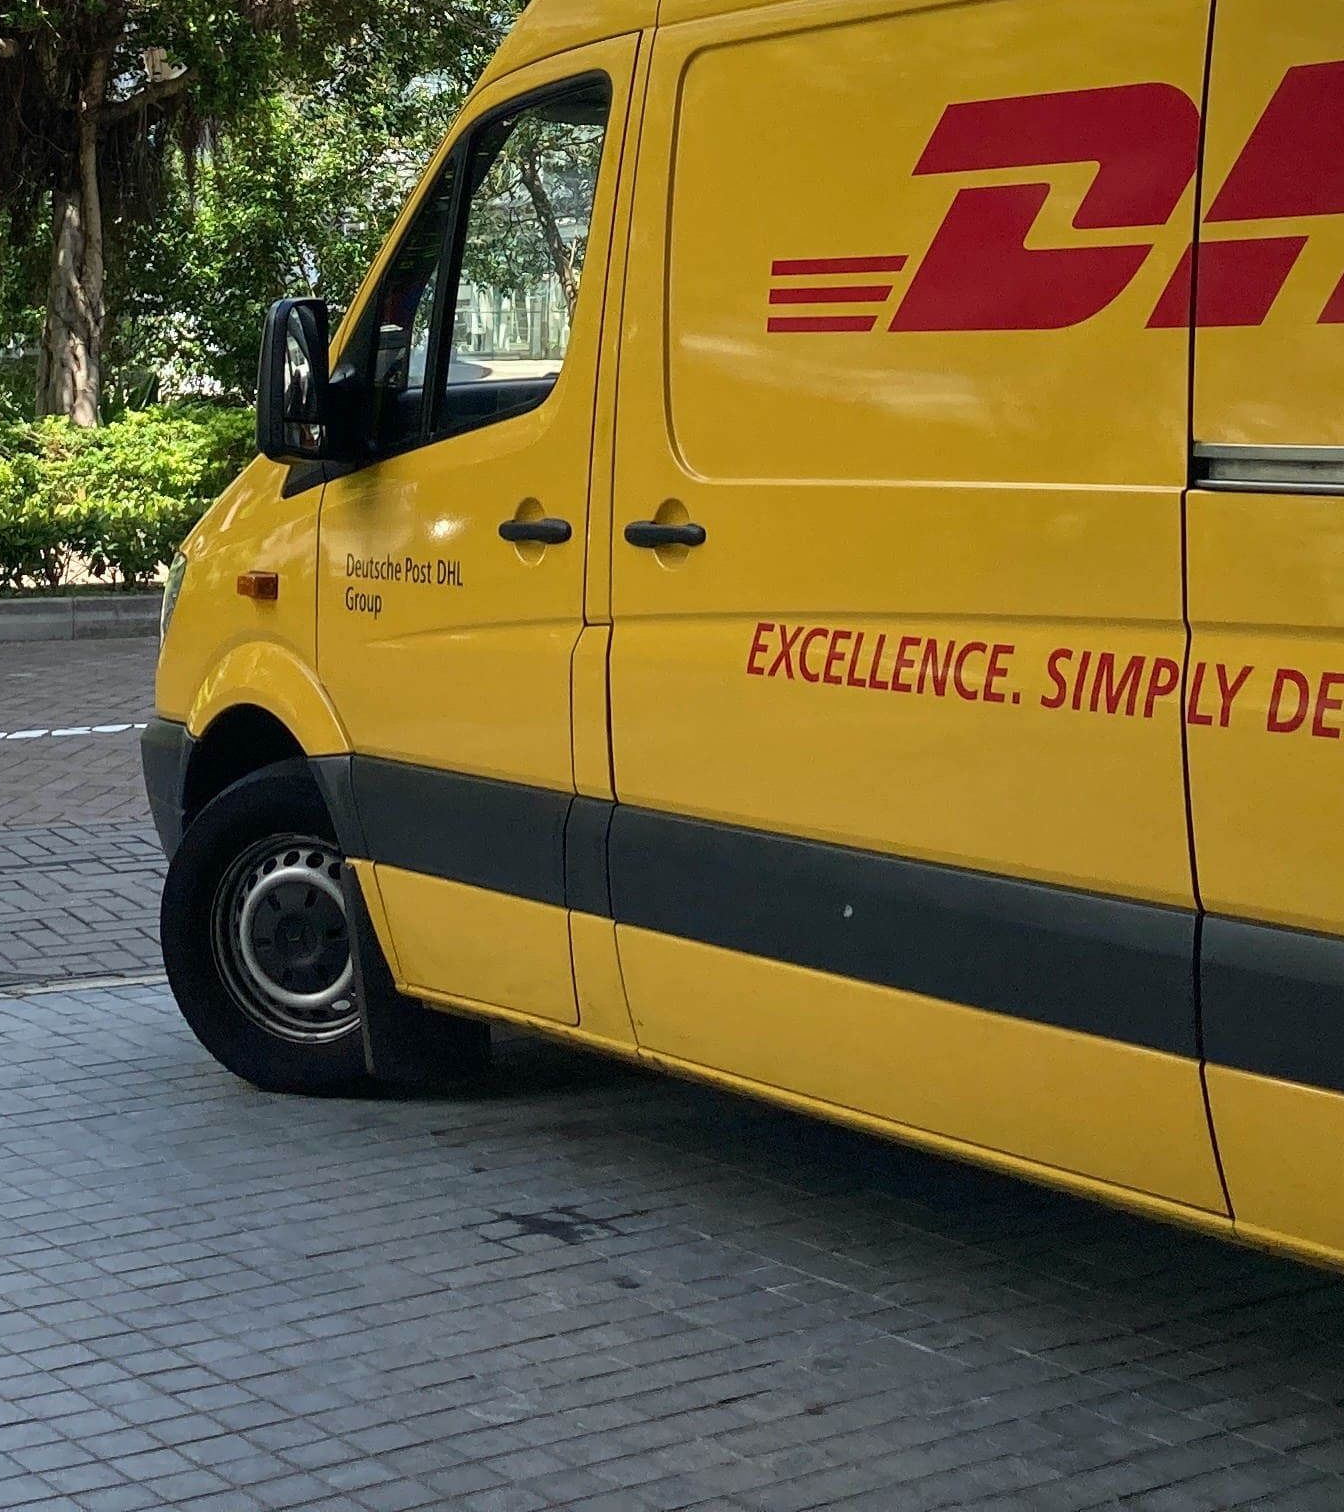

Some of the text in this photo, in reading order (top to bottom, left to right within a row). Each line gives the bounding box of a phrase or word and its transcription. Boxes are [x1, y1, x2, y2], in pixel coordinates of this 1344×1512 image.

[345, 552, 464, 587] Deutsche Post DHL
[345, 586, 383, 621] Group
[745, 620, 1022, 706] EXCELLENCE.
[1039, 646, 1254, 728] SIMPLY
